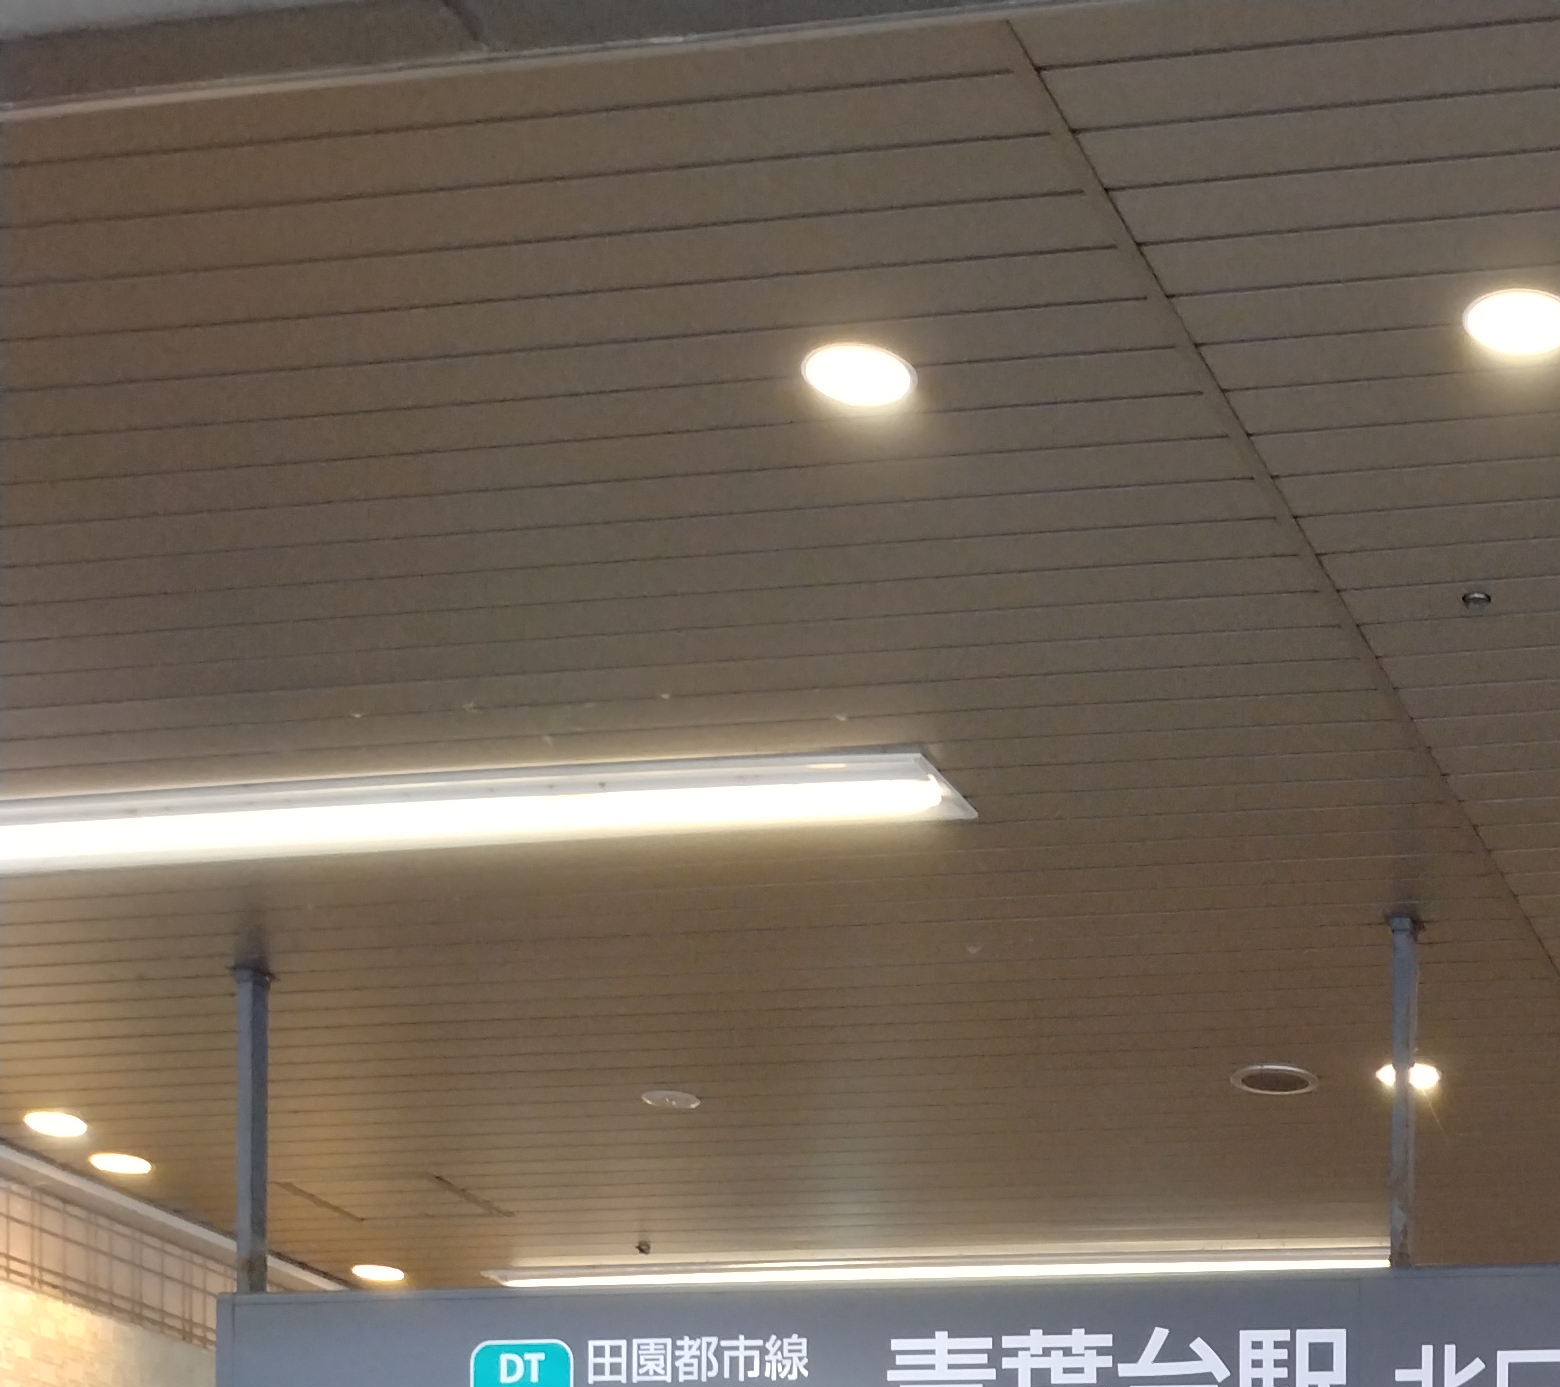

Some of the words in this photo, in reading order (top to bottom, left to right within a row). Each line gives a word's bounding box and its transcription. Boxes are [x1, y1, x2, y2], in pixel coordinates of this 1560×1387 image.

[499, 1352, 546, 1384] DT
[587, 1333, 810, 1384] 田園都市線
